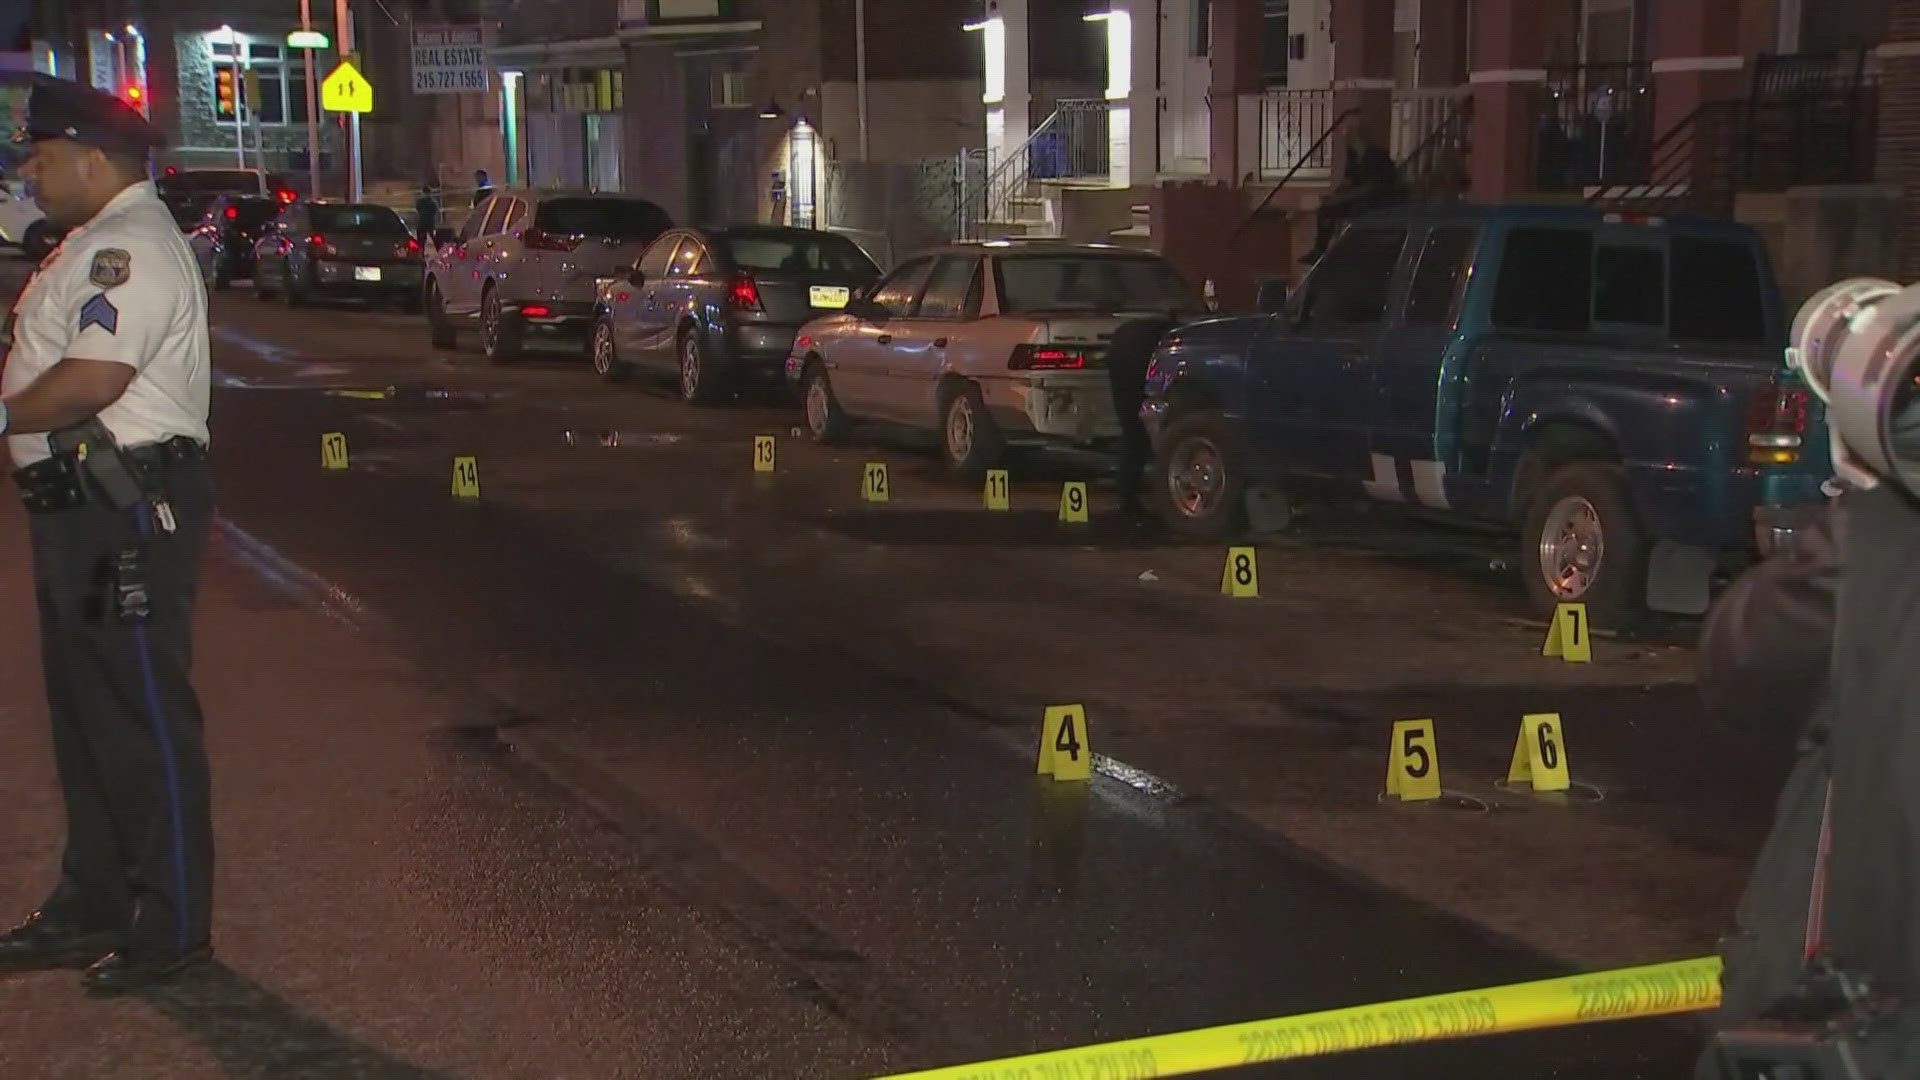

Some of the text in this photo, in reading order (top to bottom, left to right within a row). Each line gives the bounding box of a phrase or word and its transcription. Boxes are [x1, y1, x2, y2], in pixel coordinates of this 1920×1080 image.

[415, 47, 482, 67] REAL ESTATE
[327, 435, 343, 461] 17
[757, 440, 773, 462] 13
[458, 462, 477, 486] 14
[868, 467, 885, 493] 12
[989, 473, 1006, 499] 11
[1069, 487, 1083, 512] 9
[1235, 554, 1252, 585] 8
[1567, 610, 1579, 645] 7
[1056, 714, 1080, 761] 4
[1537, 722, 1558, 770] 6
[1404, 728, 1430, 778] 5
